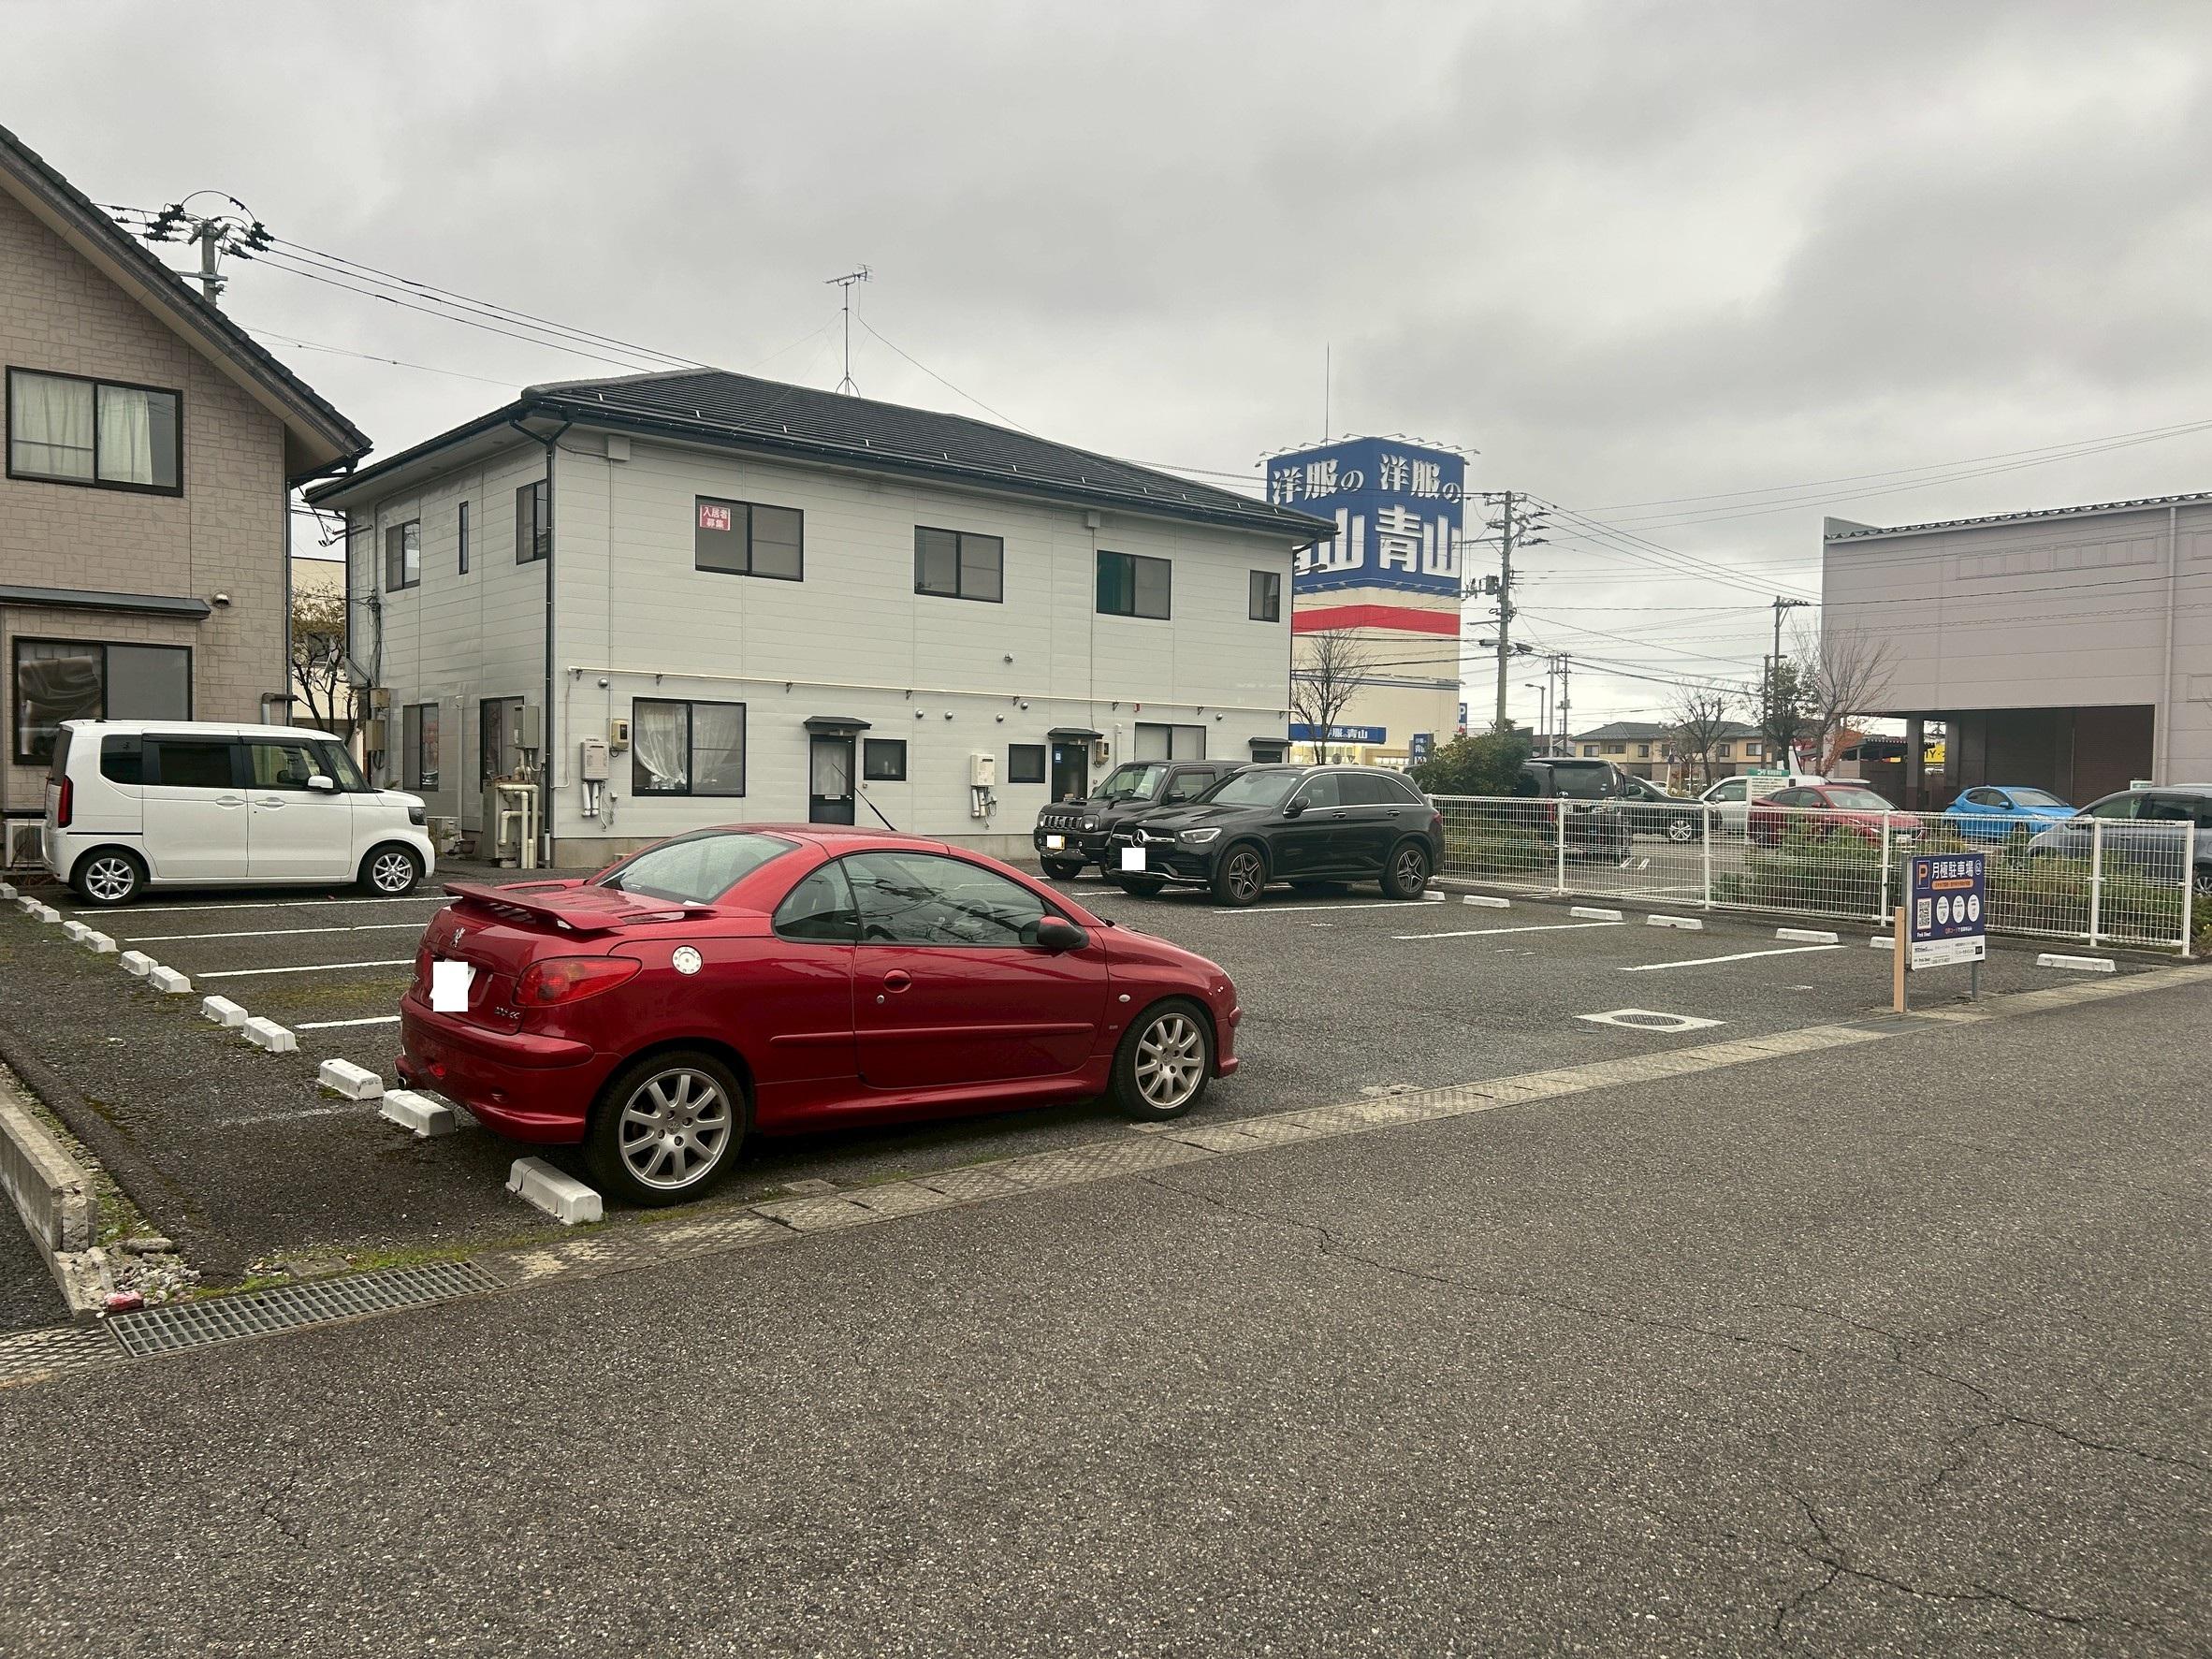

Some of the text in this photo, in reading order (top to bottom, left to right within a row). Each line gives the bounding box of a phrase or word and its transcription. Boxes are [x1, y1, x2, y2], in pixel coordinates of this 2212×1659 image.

[1273, 458, 1365, 505] 洋服の
[1379, 453, 1462, 504] 洋服の
[703, 506, 728, 519] 入居者
[1375, 503, 1462, 579] 青山
[1918, 864, 1928, 886] P
[1931, 860, 1974, 880] 月極駐車場
